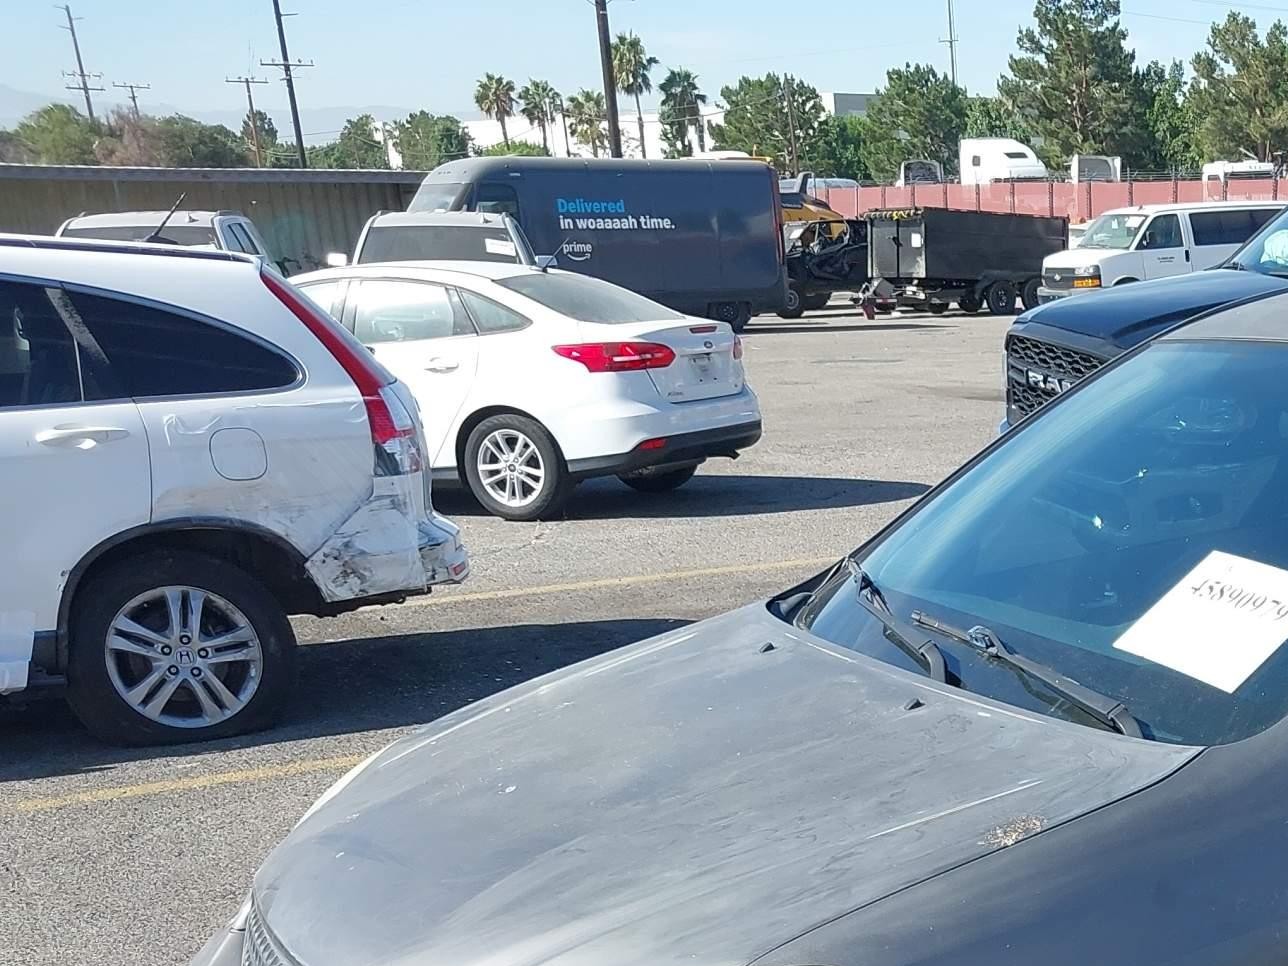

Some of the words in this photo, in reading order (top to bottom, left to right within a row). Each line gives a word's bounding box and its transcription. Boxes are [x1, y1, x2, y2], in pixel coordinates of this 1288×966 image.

[557, 198, 625, 213] Delivered
[559, 215, 573, 229] in
[575, 215, 638, 229] woaaaah
[640, 215, 675, 229] time.
[563, 241, 592, 254] prime
